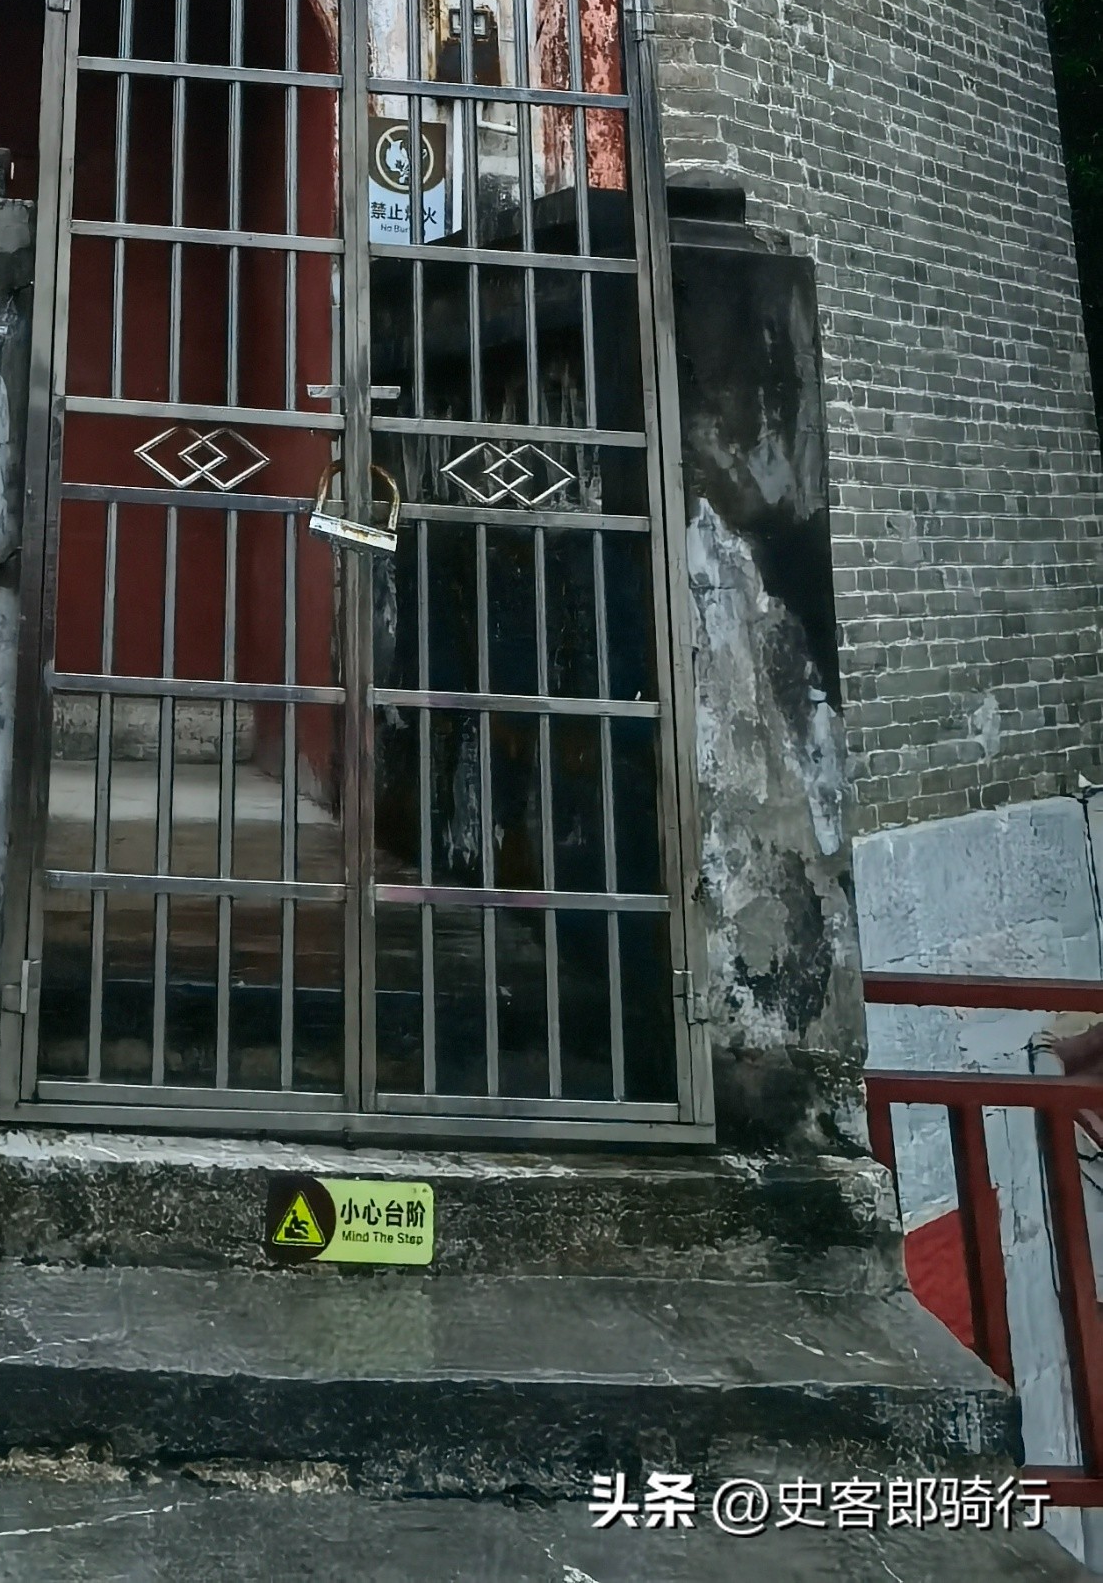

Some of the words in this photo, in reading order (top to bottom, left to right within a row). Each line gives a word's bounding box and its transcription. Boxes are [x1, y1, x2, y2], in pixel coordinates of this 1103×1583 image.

[340, 1197, 426, 1228] 小心台阶
[342, 1230, 369, 1243] Mind
[373, 1231, 394, 1244] The
